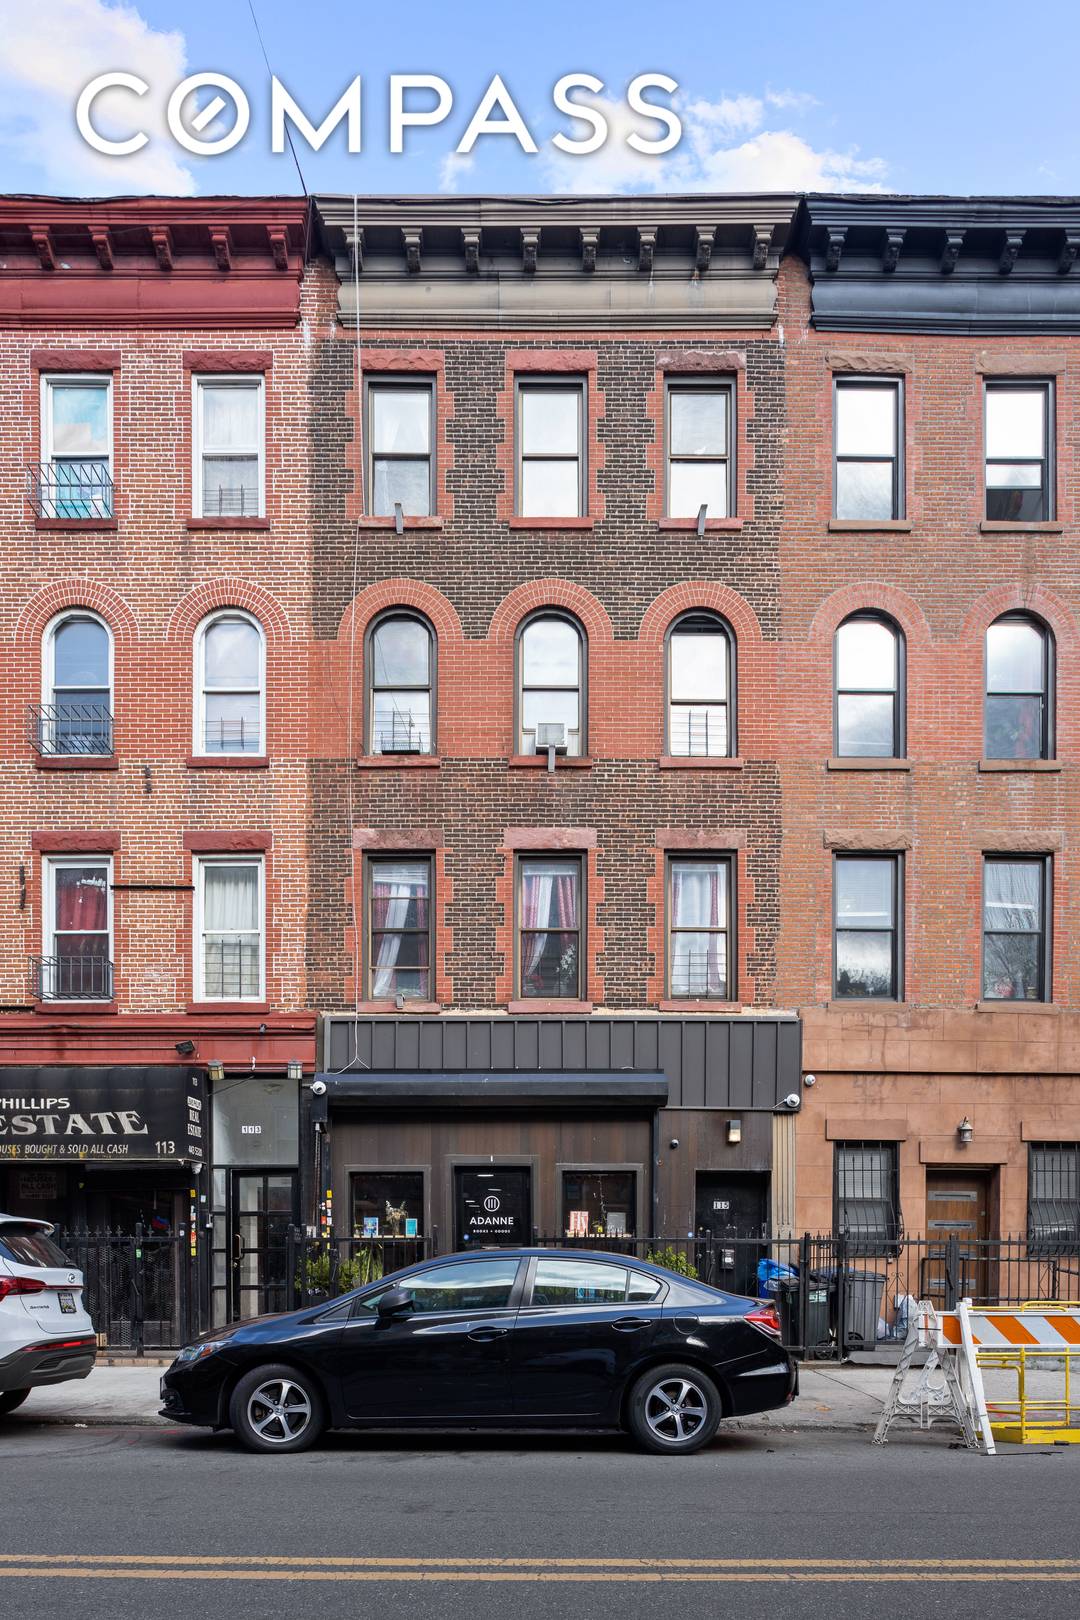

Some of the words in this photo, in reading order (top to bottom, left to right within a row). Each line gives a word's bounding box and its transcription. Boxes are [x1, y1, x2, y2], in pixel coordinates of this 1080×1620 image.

[0, 1097, 70, 1109] HILLIPS
[242, 1125, 261, 1134] 113
[25, 1144, 57, 1155] BOUGHT
[60, 1144, 65, 1154] &
[67, 1144, 89, 1154] SOLD
[90, 1144, 105, 1154] ALL
[106, 1144, 129, 1154] CASH
[155, 1141, 176, 1154] 113
[469, 1216, 514, 1225] ADANNE
